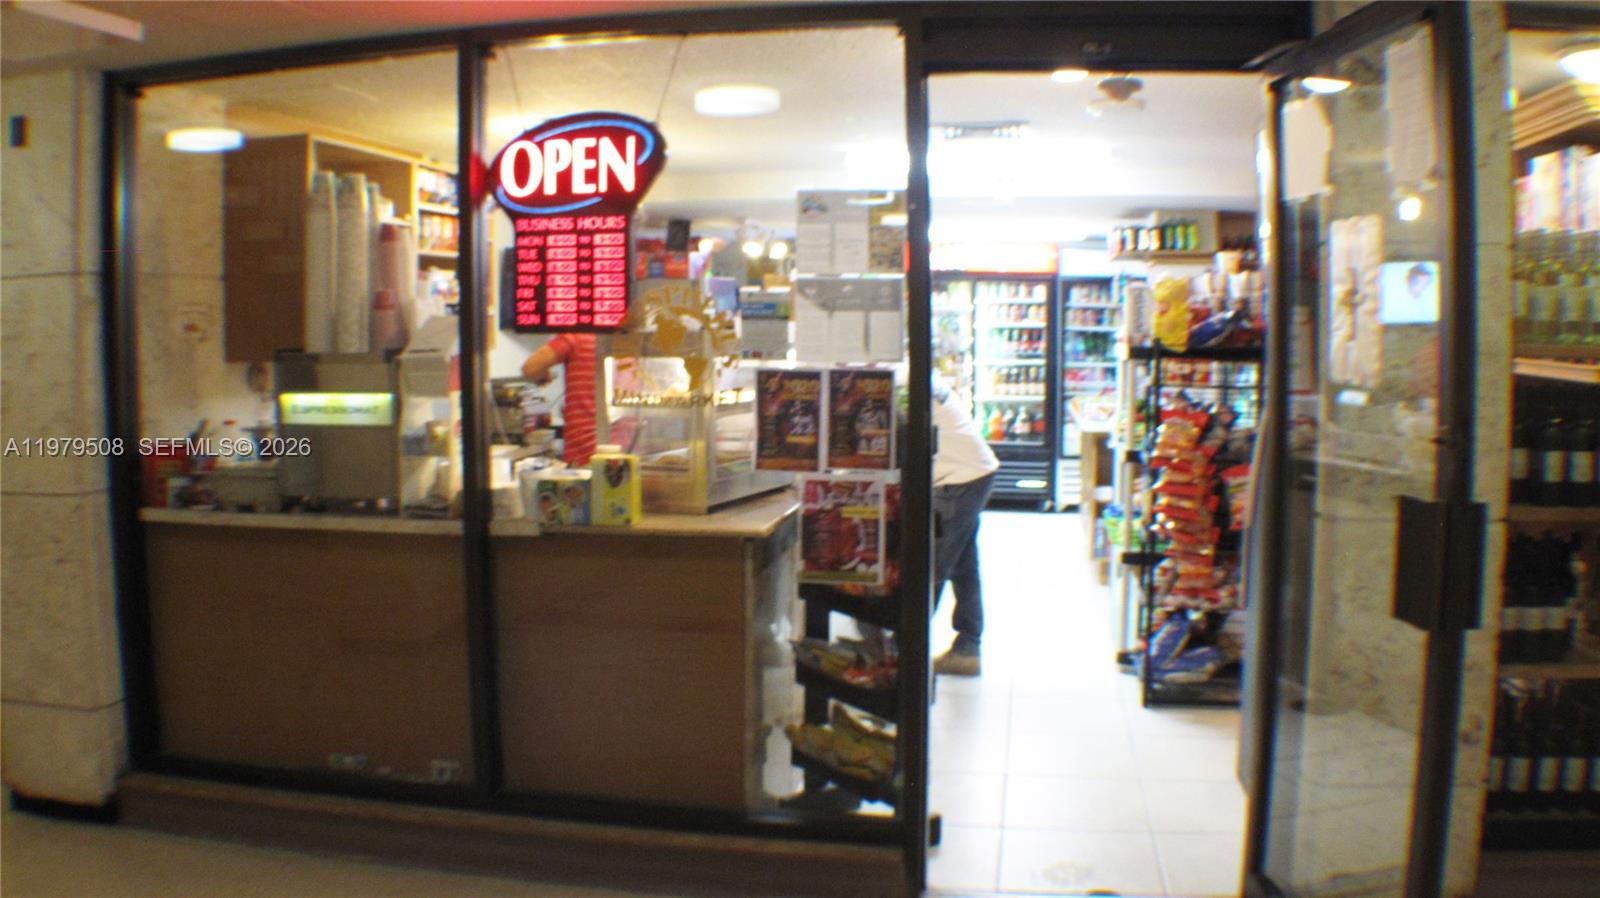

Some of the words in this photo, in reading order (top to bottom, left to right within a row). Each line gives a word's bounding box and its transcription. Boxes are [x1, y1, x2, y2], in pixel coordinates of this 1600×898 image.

[500, 135, 636, 198] OPEN
[516, 217, 574, 231] BUSINESS
[577, 215, 626, 230] HOURS
[516, 236, 544, 247] MON
[517, 250, 538, 260] TUE
[517, 262, 543, 273] WED
[517, 275, 541, 285] THU
[516, 288, 535, 299] FRI
[516, 301, 537, 312] SAT
[516, 314, 541, 325] SUN
